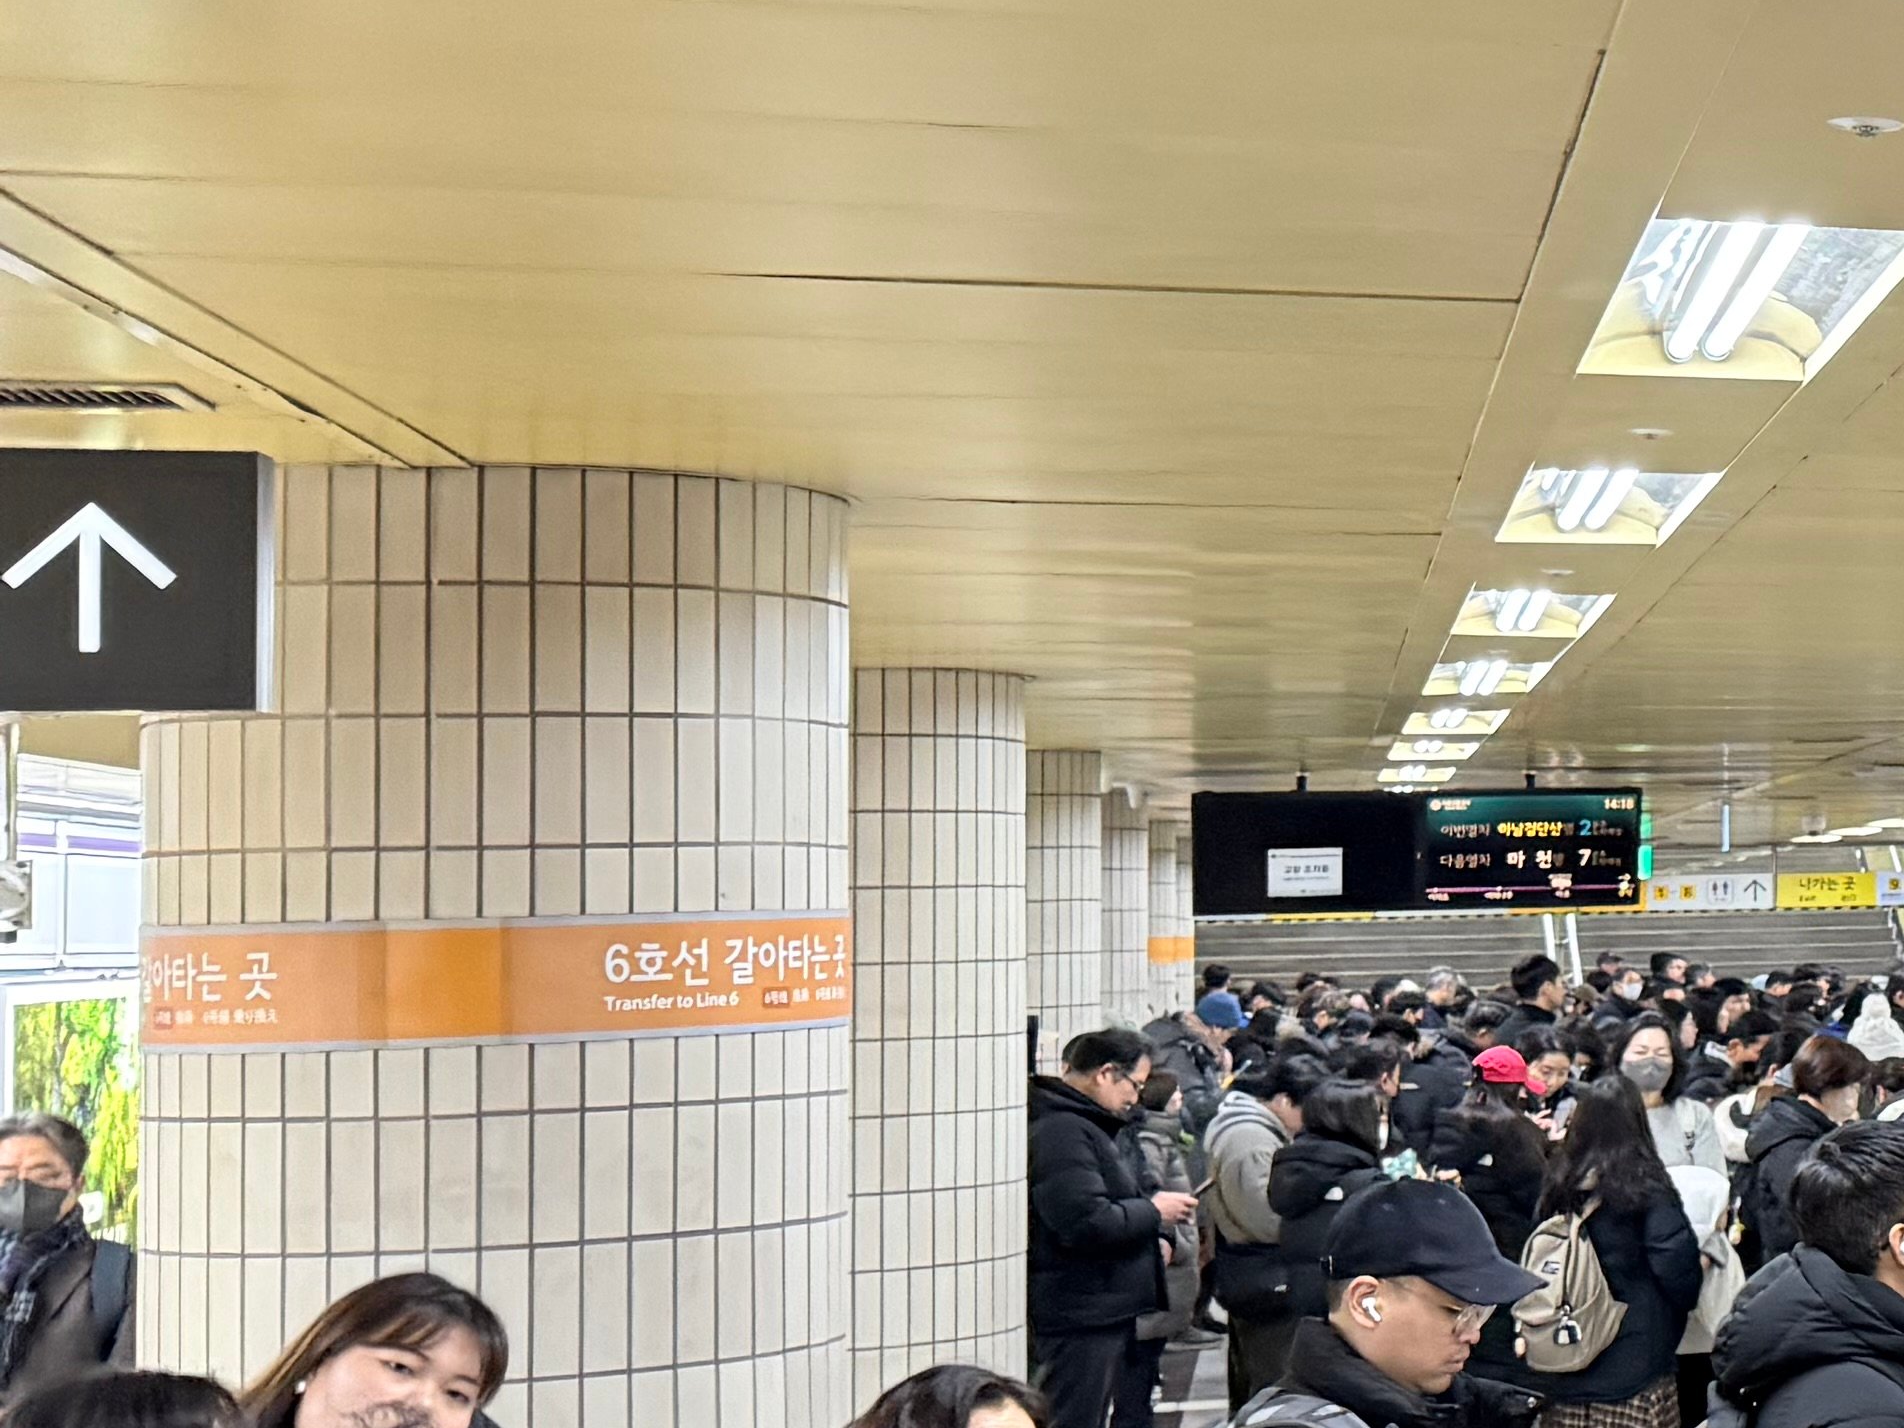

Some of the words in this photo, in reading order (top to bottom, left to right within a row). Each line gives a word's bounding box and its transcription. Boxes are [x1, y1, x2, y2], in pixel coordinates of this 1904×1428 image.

[239, 952, 278, 1001] 곳
[604, 937, 710, 986] 6호선
[723, 934, 831, 986] 갈아타는
[832, 934, 846, 977] 곳
[604, 993, 675, 1011] Transfer
[676, 994, 694, 1008] to
[696, 991, 727, 1008] Line
[728, 991, 740, 1006] 6
